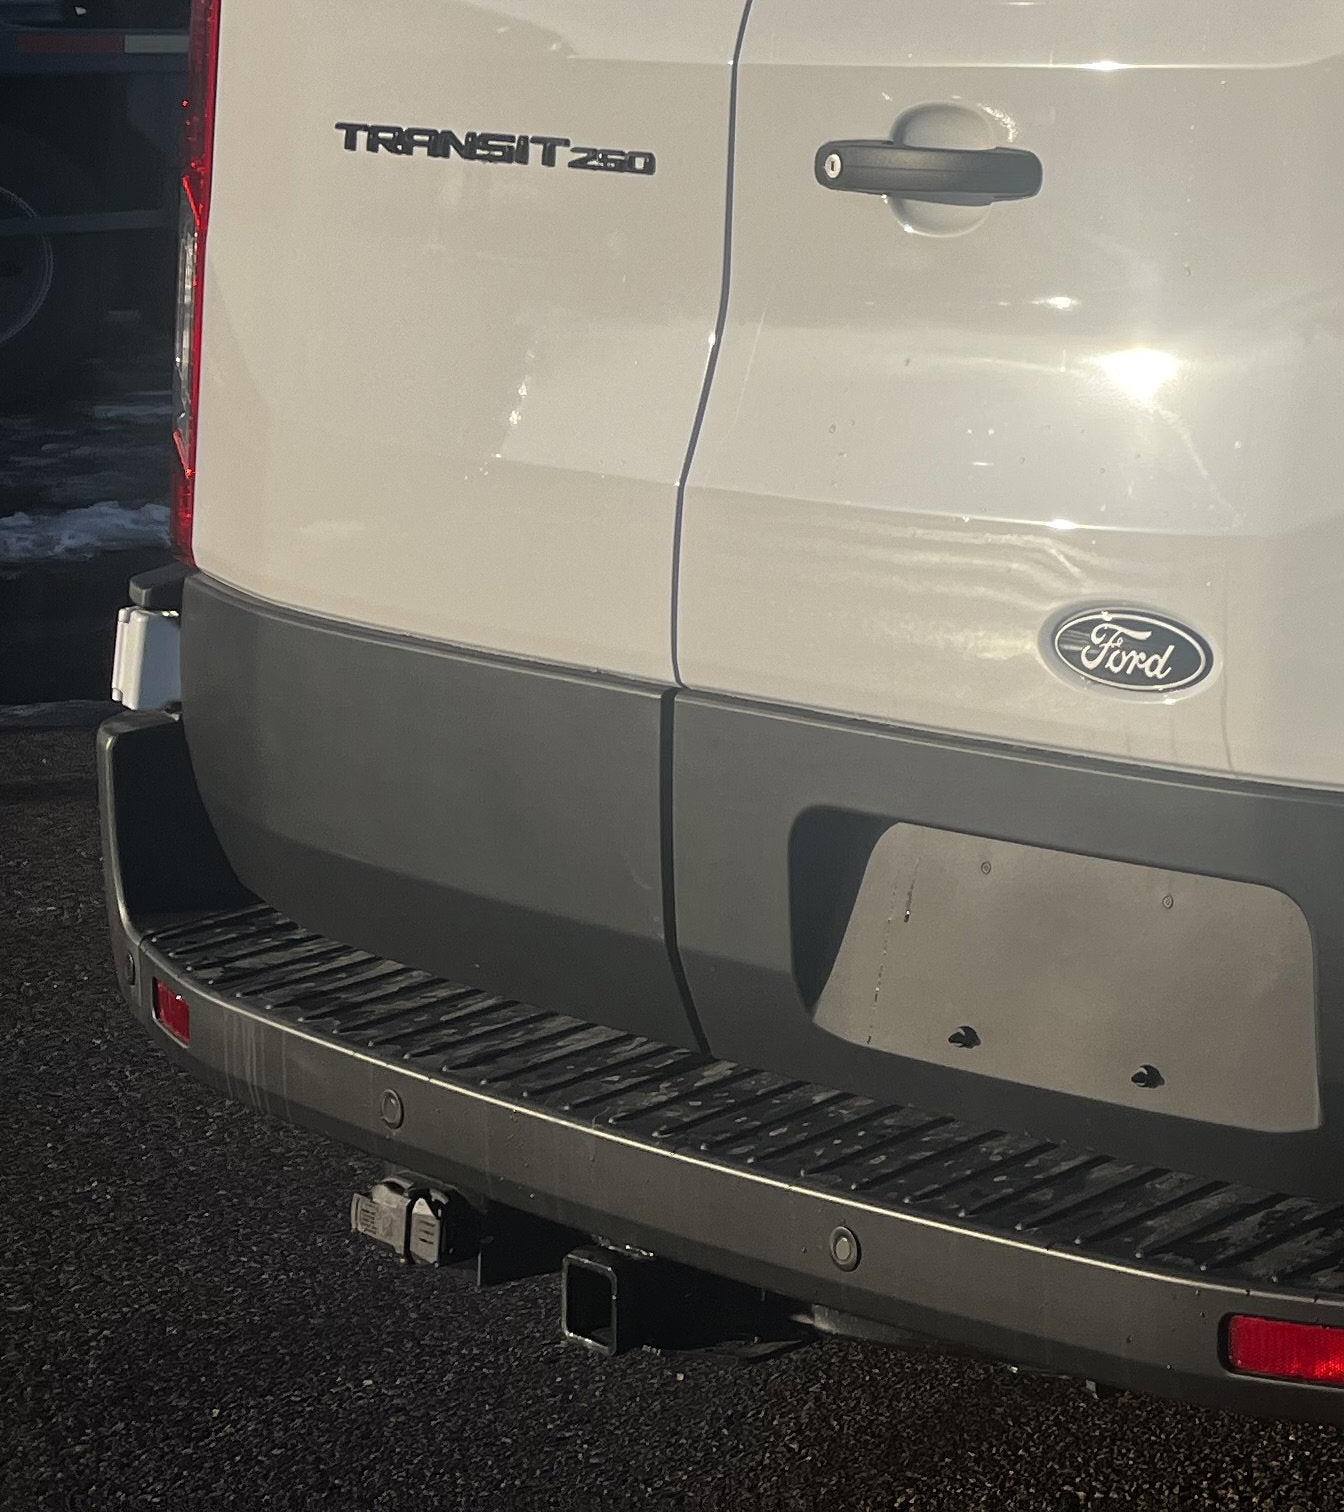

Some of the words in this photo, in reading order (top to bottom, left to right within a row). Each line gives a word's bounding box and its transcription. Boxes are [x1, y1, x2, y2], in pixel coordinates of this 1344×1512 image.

[334, 121, 570, 168] TRANSIT
[567, 146, 656, 176] 250
[1081, 623, 1175, 679] Ford
